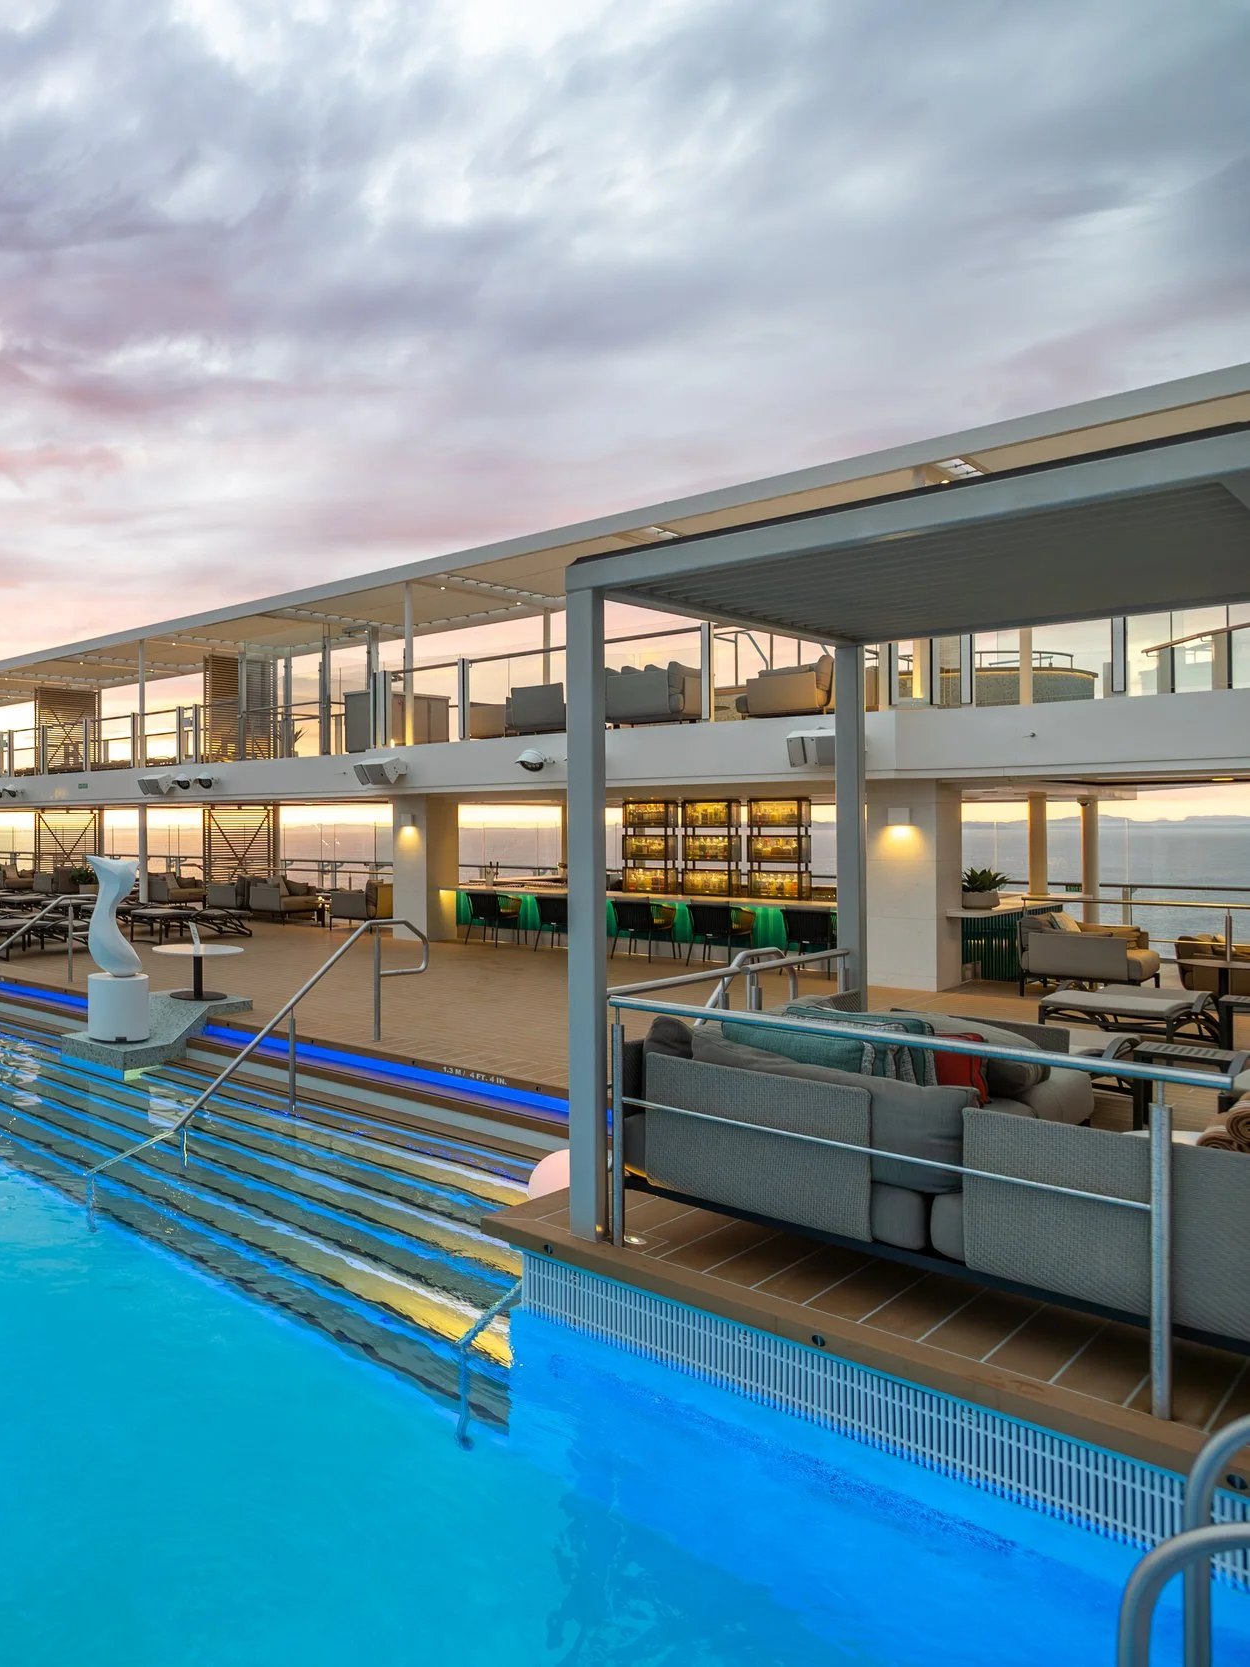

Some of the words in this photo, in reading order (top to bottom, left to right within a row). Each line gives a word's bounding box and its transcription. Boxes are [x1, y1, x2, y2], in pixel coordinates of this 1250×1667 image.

[442, 1066, 454, 1074] 1.3
[469, 1071, 475, 1079] 4
[476, 1073, 488, 1081] FT.
[496, 1077, 507, 1085] IN.
